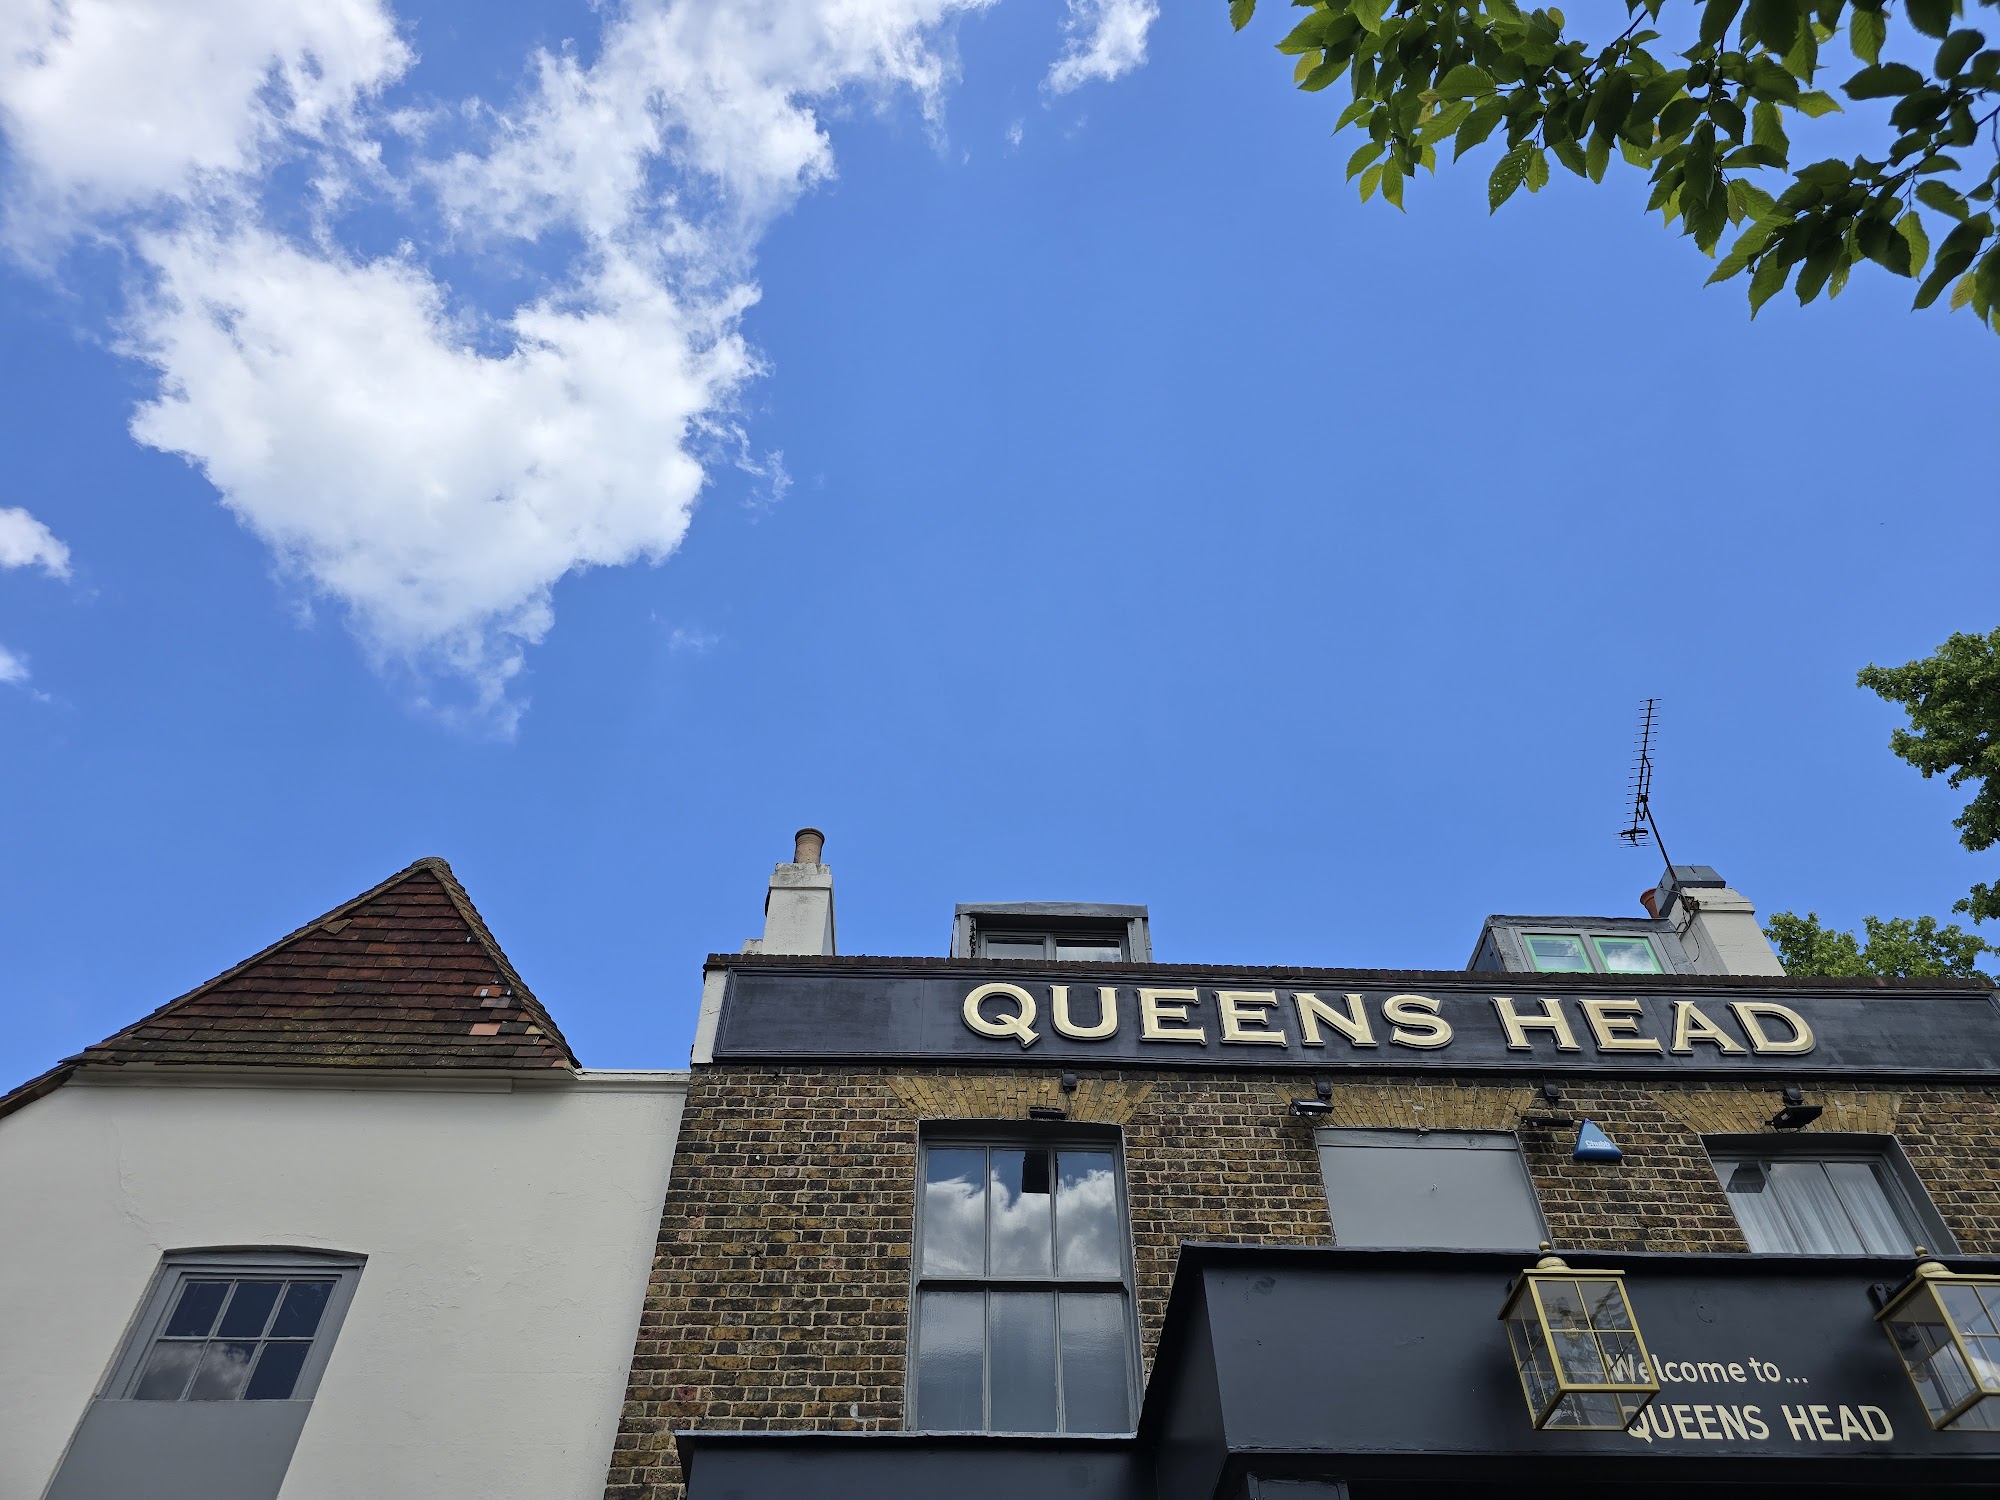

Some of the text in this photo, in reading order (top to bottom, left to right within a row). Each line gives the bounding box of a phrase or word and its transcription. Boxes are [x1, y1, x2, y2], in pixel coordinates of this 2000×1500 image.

[962, 982, 1815, 1055] QUEENS HEAD
[1605, 1353, 1748, 1383] Welcome
[1622, 1405, 1894, 1443] QUEENS HEAD
